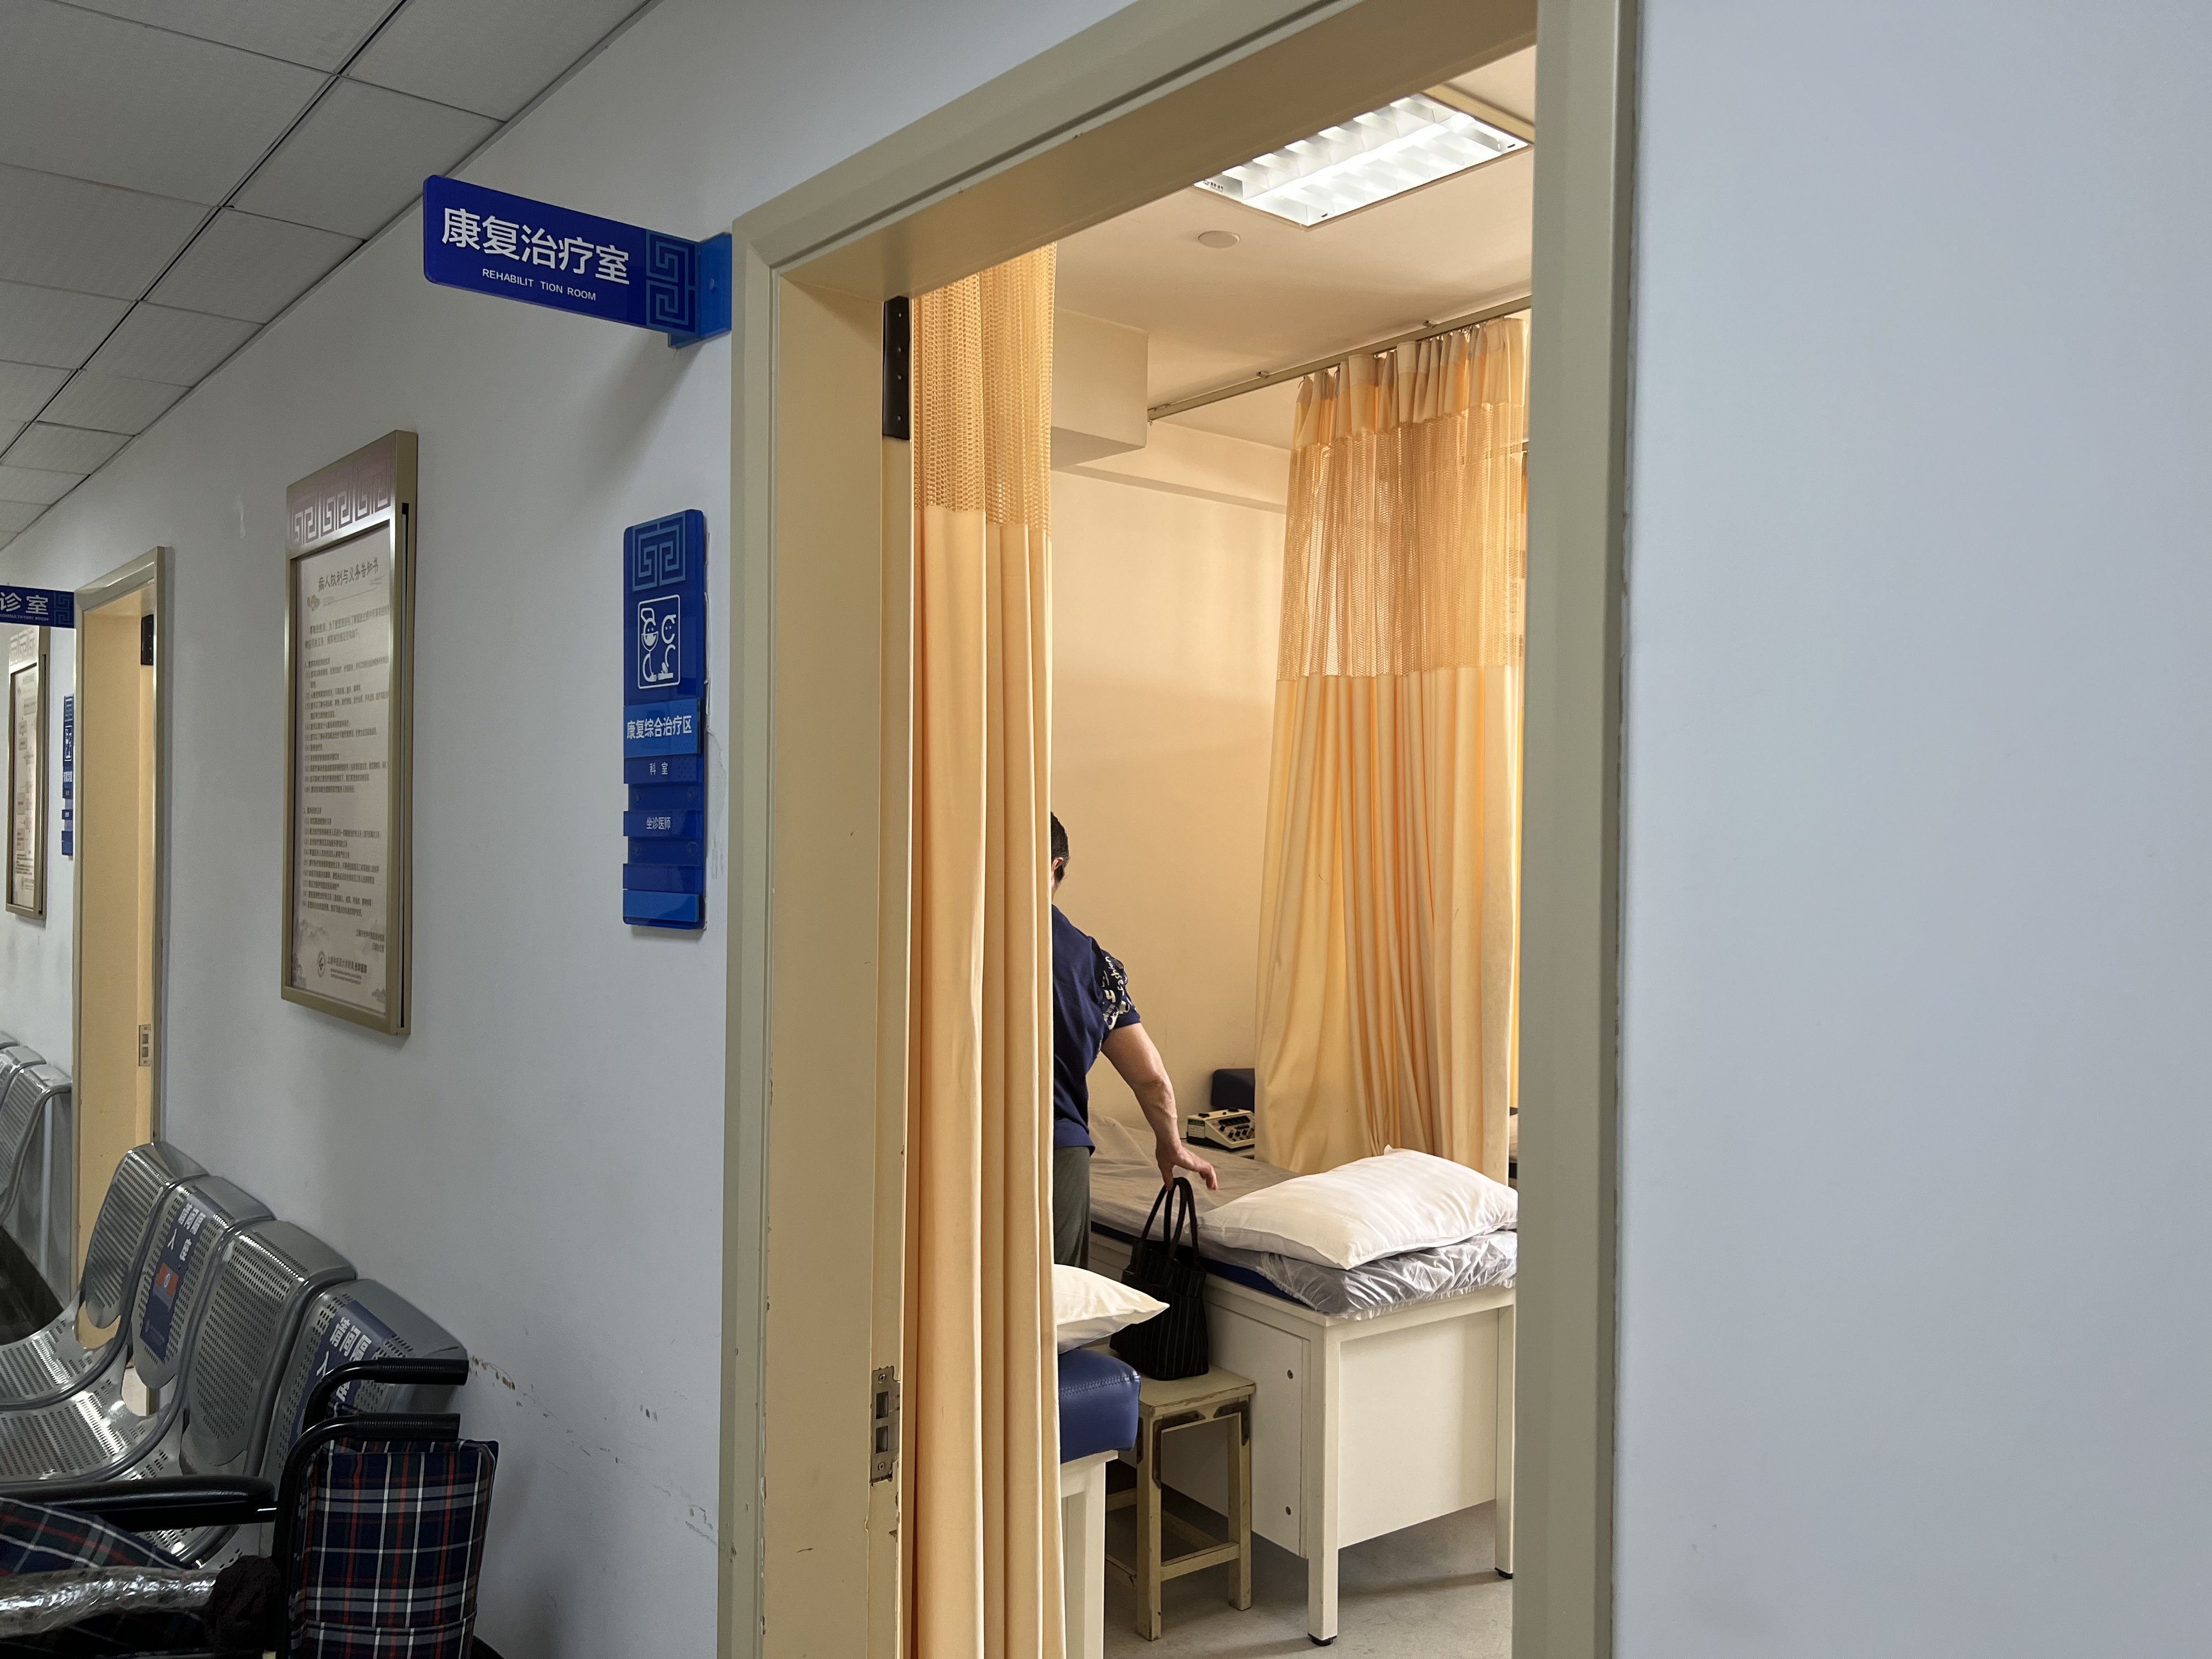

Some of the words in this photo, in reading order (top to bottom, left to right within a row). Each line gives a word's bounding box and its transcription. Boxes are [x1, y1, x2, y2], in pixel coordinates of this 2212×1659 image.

[442, 207, 630, 285] 康复治疗室
[483, 268, 534, 287] REHABILIT
[540, 280, 563, 294] TION
[567, 287, 596, 301] ROOM
[318, 557, 379, 592] 病人权利与义务告知书
[0, 592, 49, 615] 诊室
[627, 715, 692, 740] 康复综合治疗区
[650, 761, 668, 776] 科室
[646, 816, 671, 830] 坐诊医师
[329, 1317, 372, 1361] 请间隔
